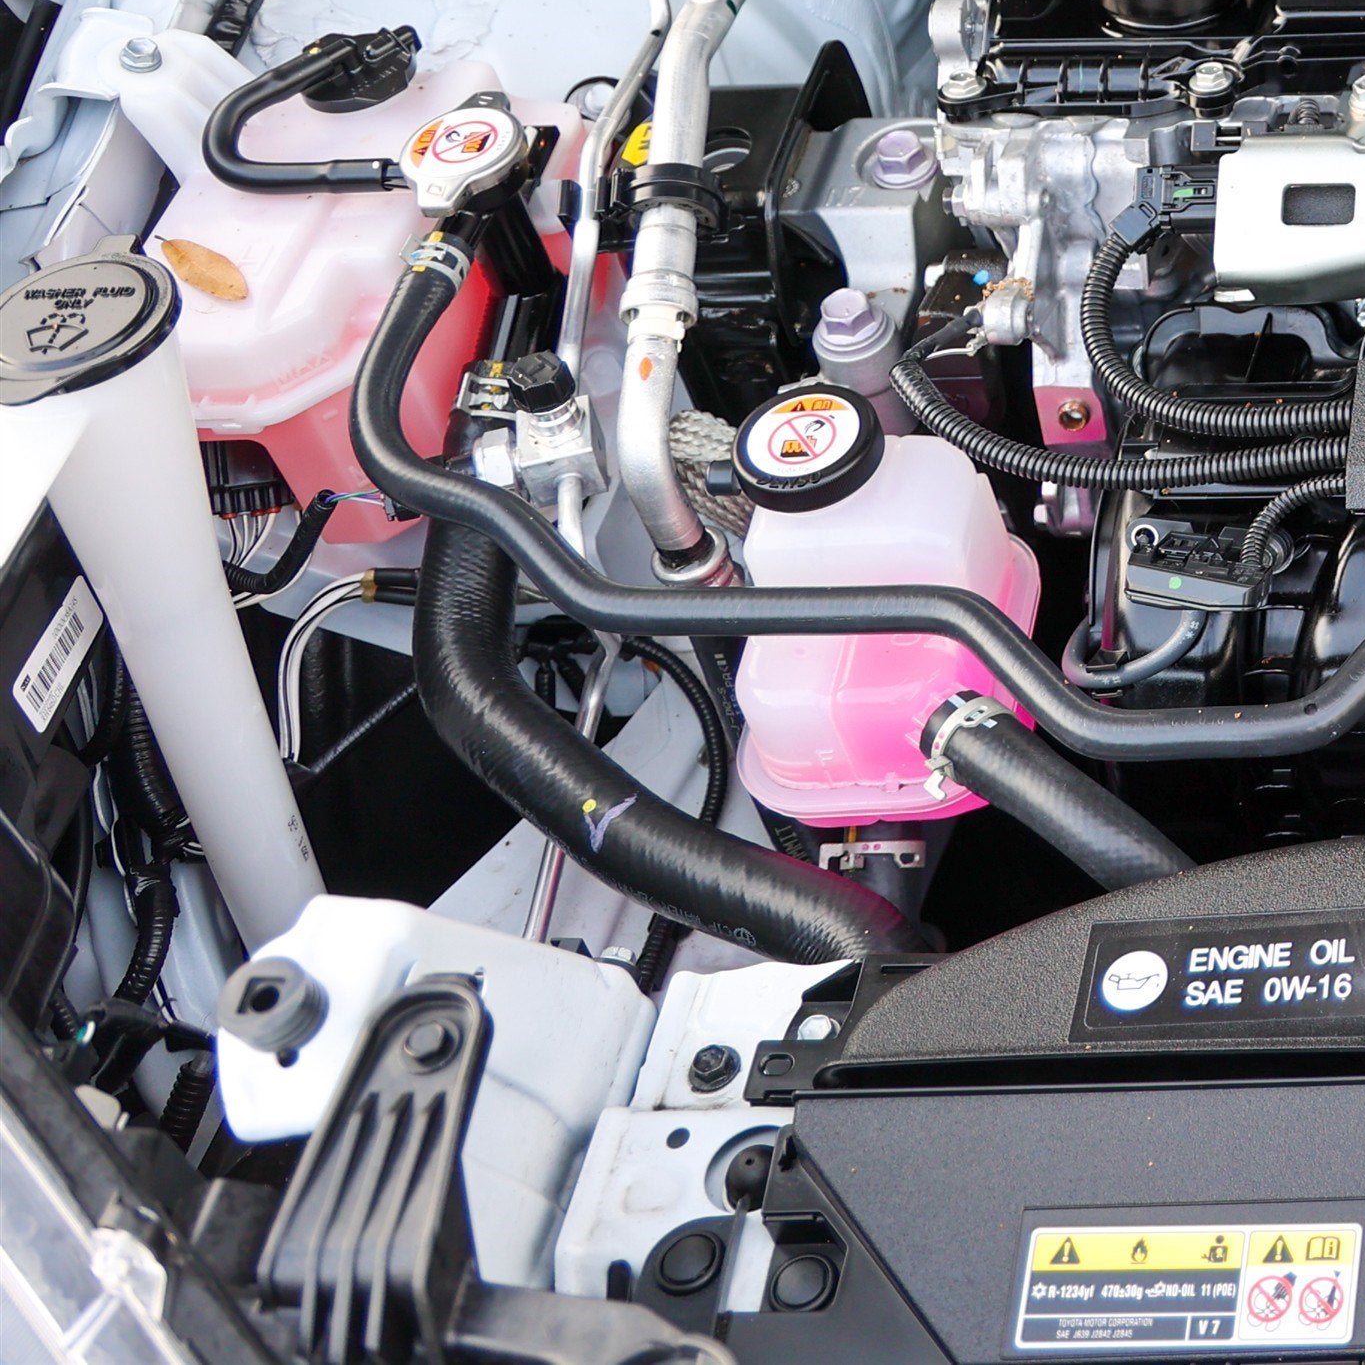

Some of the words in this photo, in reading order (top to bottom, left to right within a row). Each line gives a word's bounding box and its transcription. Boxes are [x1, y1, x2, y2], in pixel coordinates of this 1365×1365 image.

[24, 287, 87, 301] WASHER
[92, 286, 136, 299] FLUID
[54, 298, 95, 310] ONLY
[755, 471, 822, 489] DENSO
[1187, 942, 1293, 973] ENGINE
[1310, 938, 1356, 966] OIL
[1184, 979, 1244, 1007] SAE
[1263, 973, 1353, 1003] 0W-16
[1047, 1284, 1095, 1300] R-1234yf
[1101, 1283, 1143, 1301] 470±30g
[1165, 1283, 1196, 1298] ND-OIL
[1201, 1283, 1211, 1297] 11
[1212, 1282, 1237, 1299] (POE)
[1056, 1330, 1070, 1339] SAE
[1073, 1330, 1089, 1339] J639
[1058, 1319, 1082, 1328] TOYOTA
[1083, 1319, 1106, 1327] MOTOR
[1107, 1318, 1154, 1327] CORPORATION
[1198, 1320, 1210, 1335] V
[1211, 1319, 1221, 1334] 7
